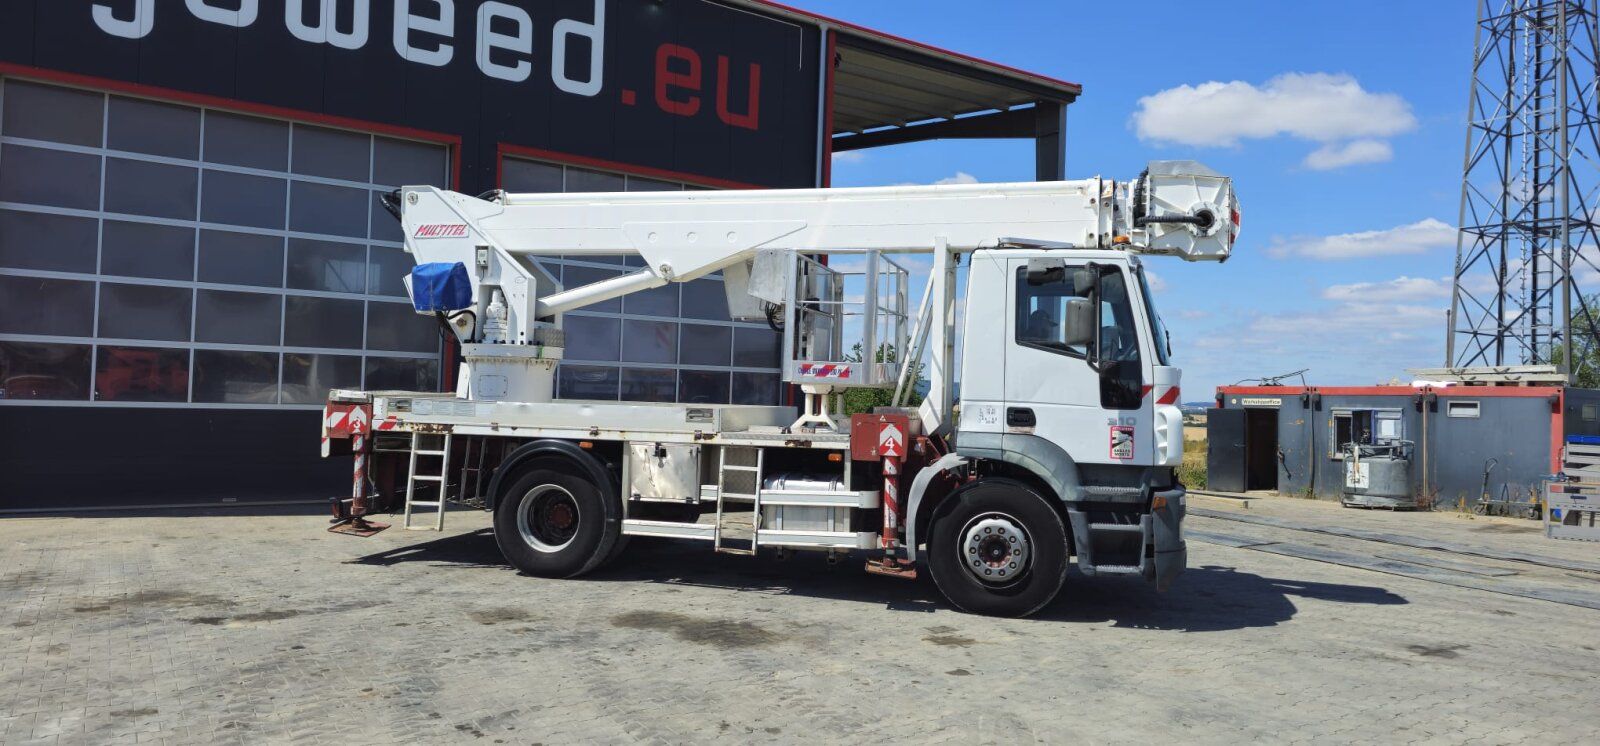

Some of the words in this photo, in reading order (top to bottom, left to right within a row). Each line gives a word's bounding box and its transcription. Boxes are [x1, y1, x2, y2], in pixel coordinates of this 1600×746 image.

[414, 224, 468, 237] MULTITEL
[353, 418, 361, 428] 3
[885, 437, 895, 449] 4
